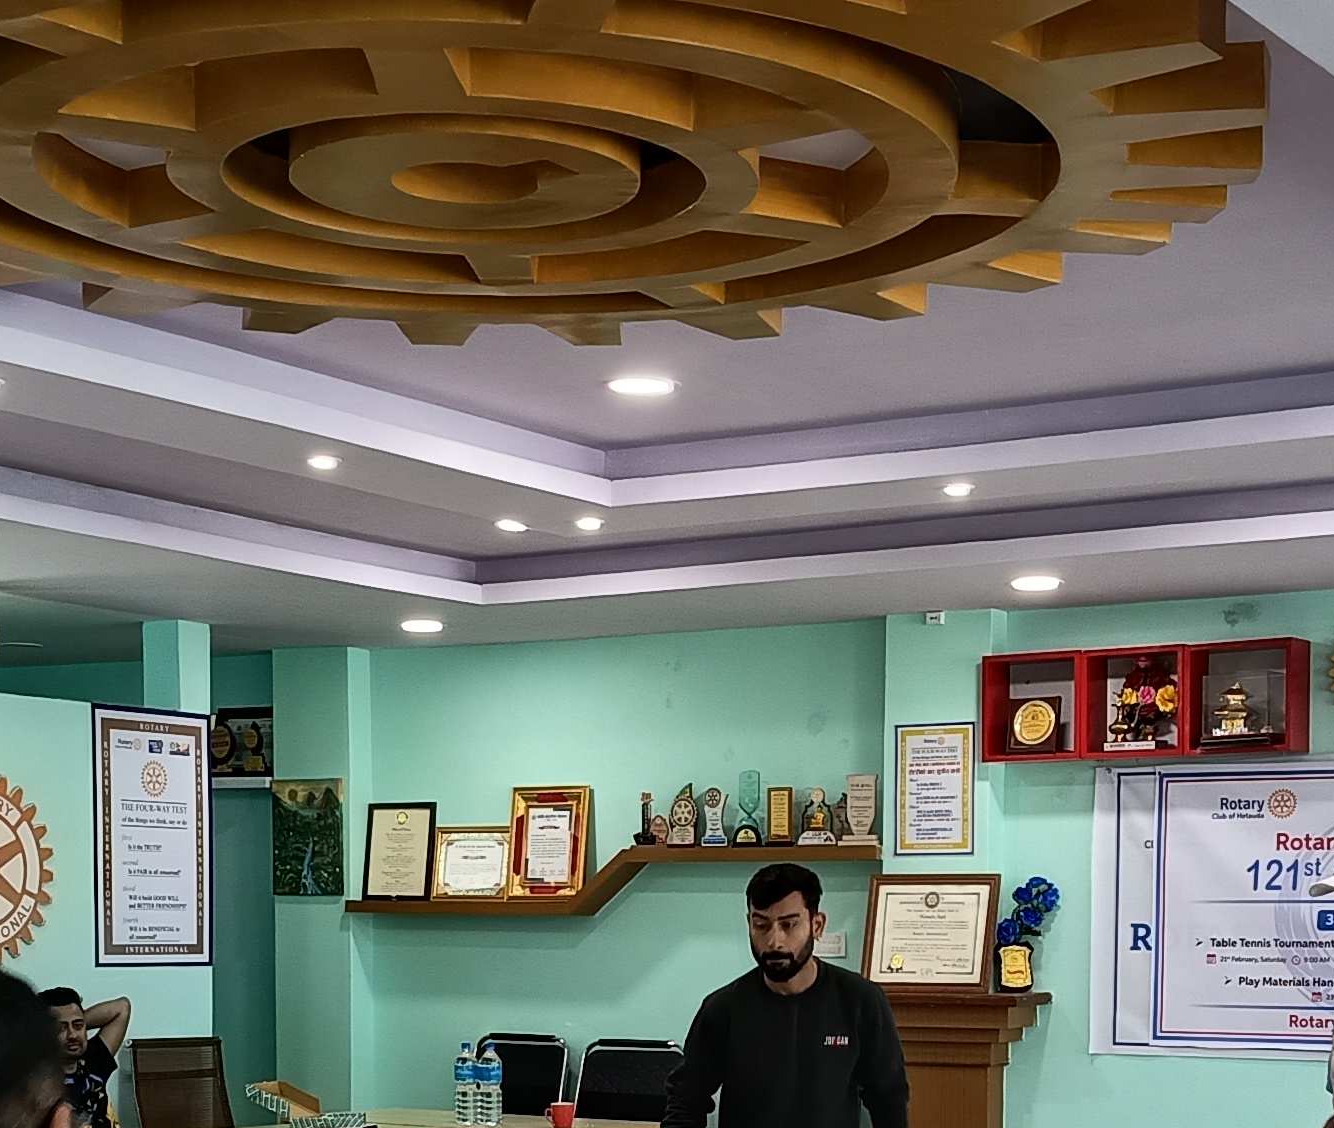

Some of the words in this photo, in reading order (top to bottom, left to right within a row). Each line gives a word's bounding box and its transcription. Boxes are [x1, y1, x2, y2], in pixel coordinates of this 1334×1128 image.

[139, 723, 170, 733] ROTARY
[121, 803, 135, 811] THE
[172, 806, 187, 814] TEST
[1220, 798, 1265, 812] Rotary
[1325, 914, 1334, 926] 3
[1210, 938, 1238, 948] Table
[1240, 938, 1272, 949] Tennis
[1238, 976, 1260, 989] Play
[1262, 977, 1310, 988] Materials
